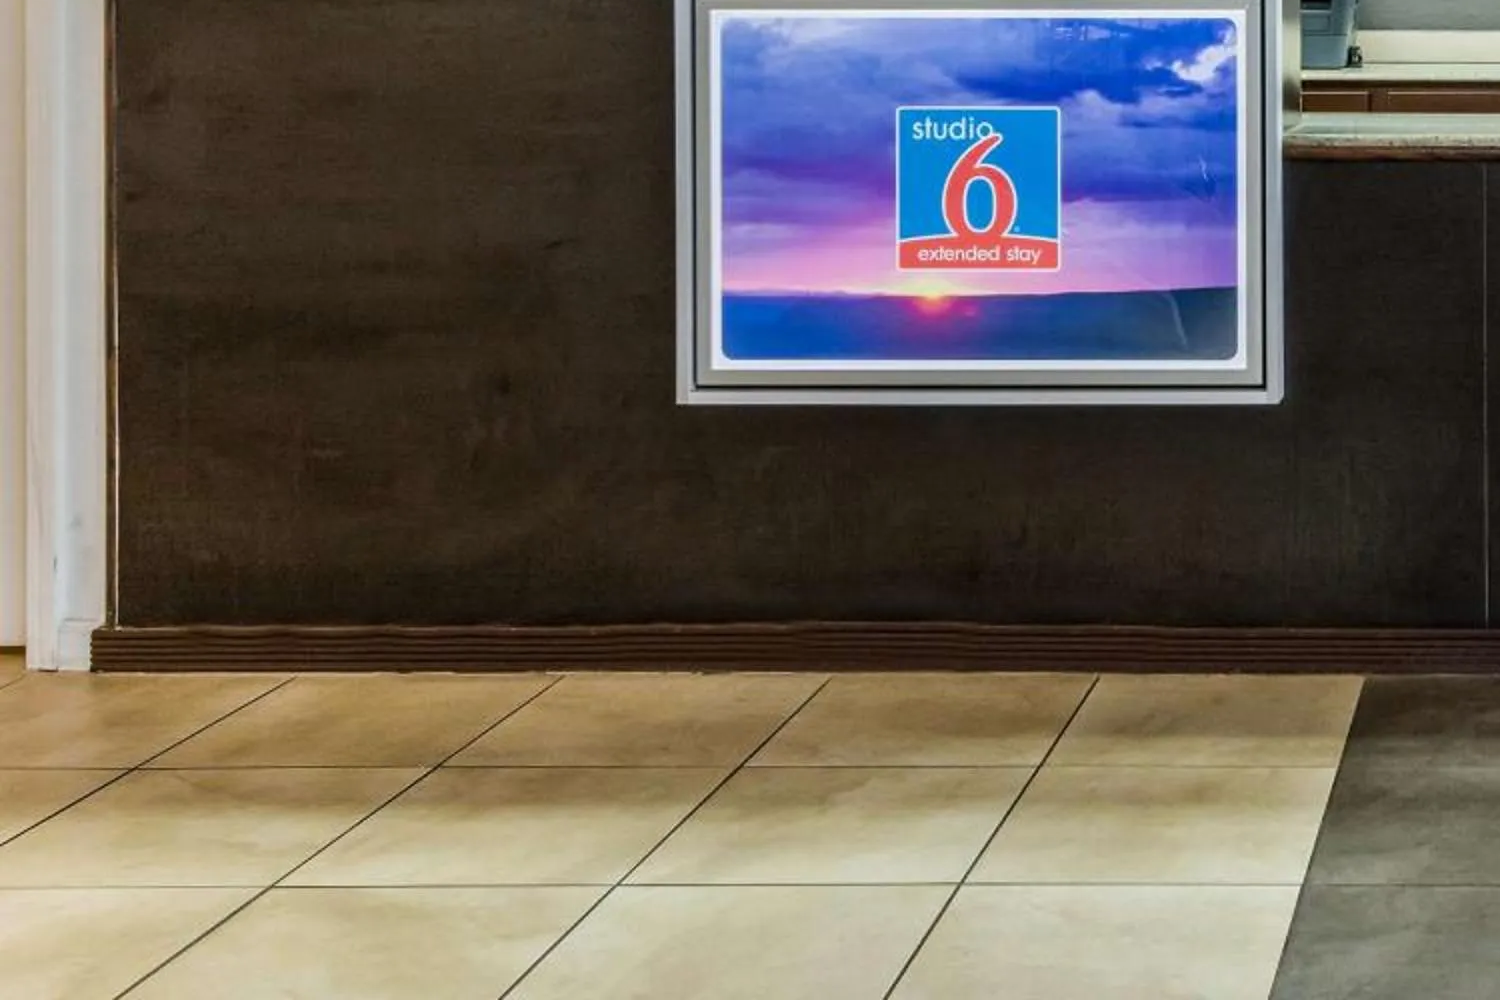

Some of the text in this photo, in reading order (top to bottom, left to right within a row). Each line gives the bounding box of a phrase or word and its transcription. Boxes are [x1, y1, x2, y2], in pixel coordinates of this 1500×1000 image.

[911, 116, 994, 140] studio
[941, 132, 1018, 238] 6
[917, 245, 1042, 265] extended stay
